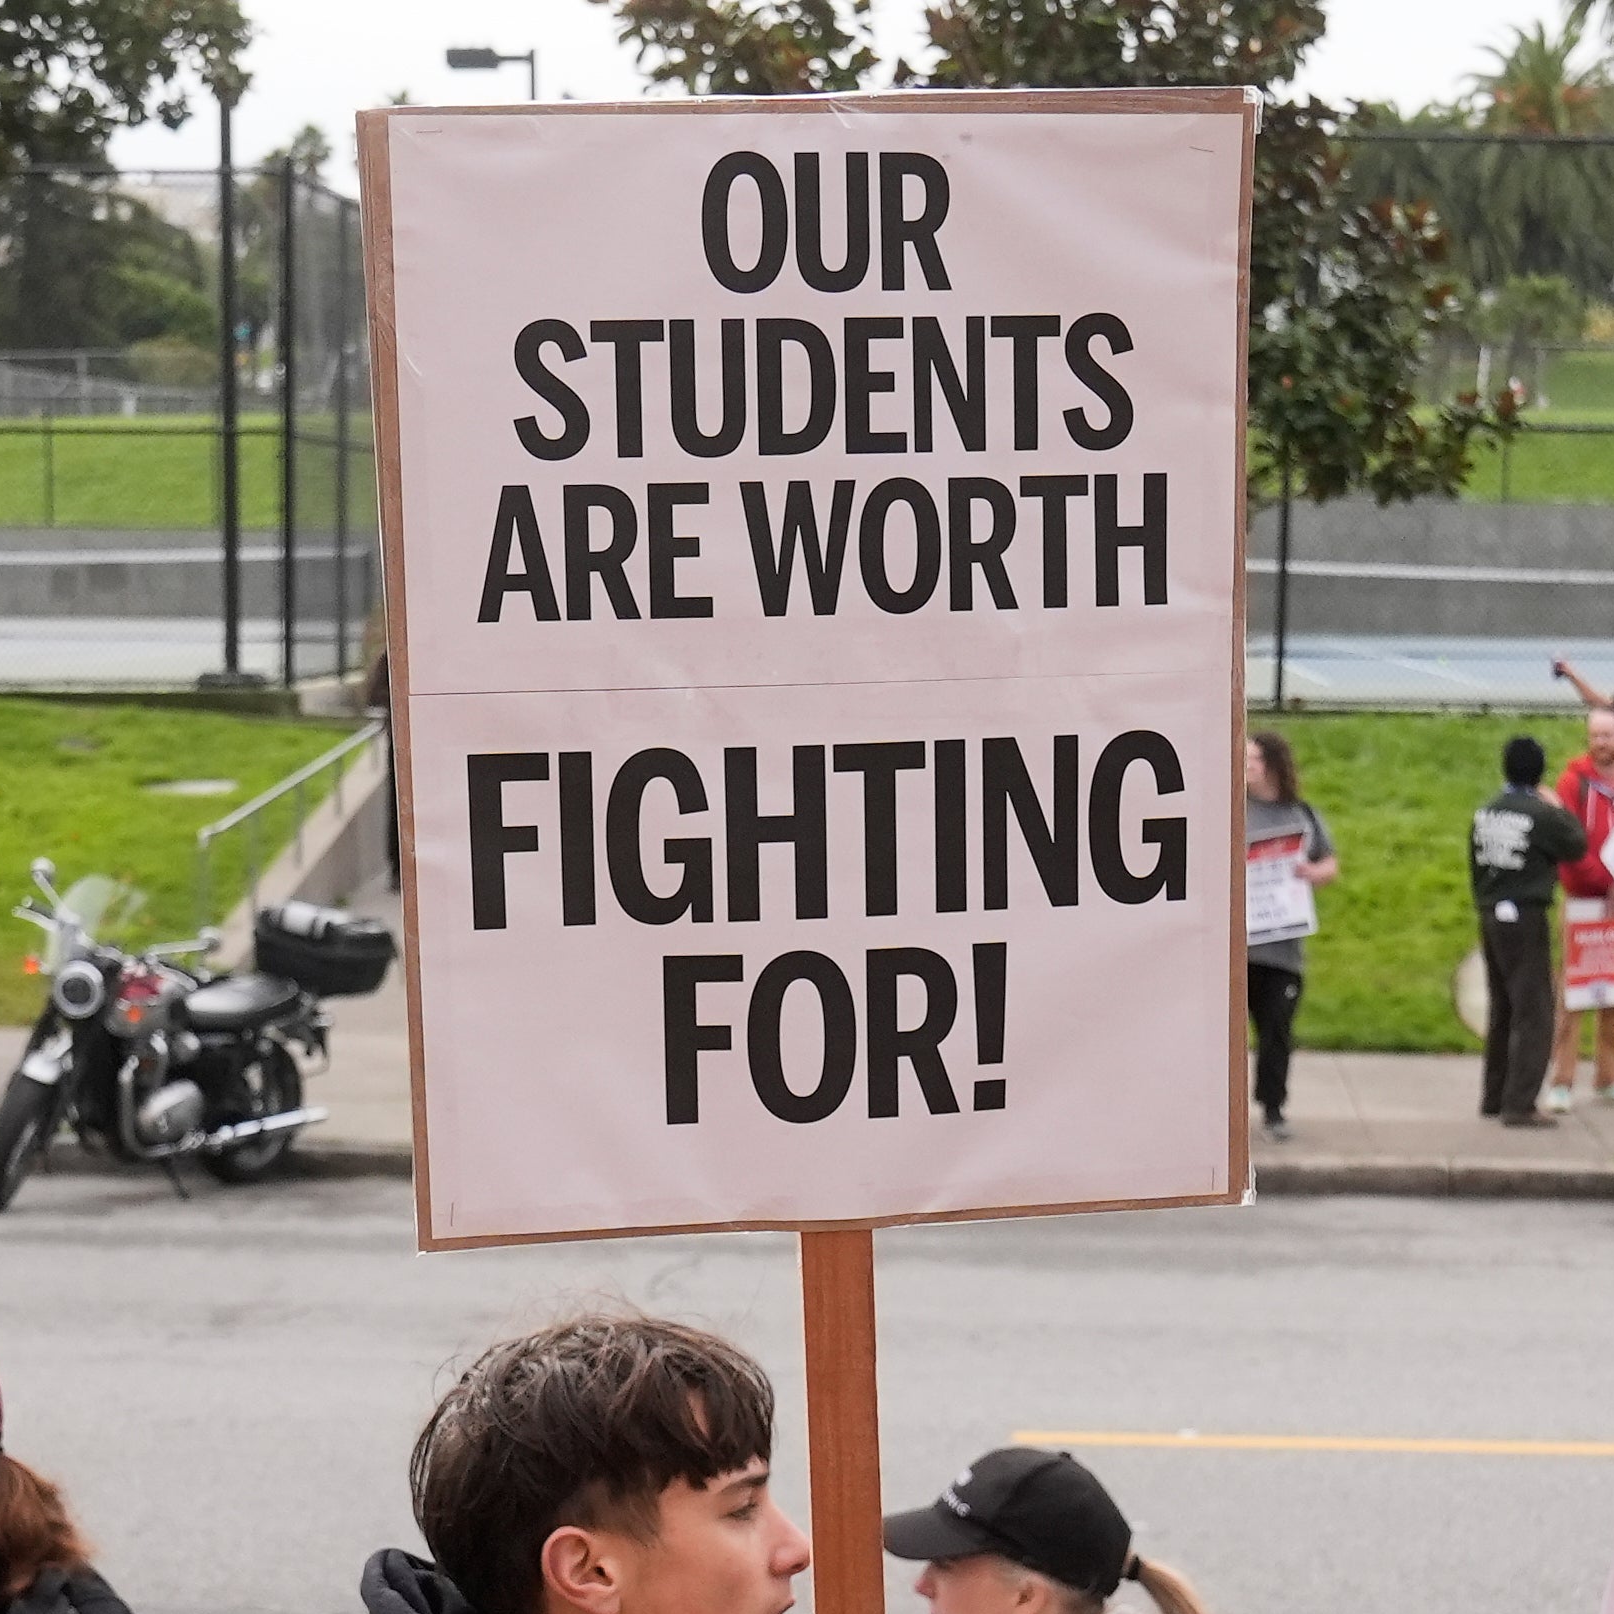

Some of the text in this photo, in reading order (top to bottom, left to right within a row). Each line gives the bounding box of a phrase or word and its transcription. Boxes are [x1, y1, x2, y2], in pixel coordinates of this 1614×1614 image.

[701, 150, 953, 294] OUR
[513, 312, 1135, 462] STUDENTS
[476, 472, 1169, 624] ARE WORTH
[466, 729, 1189, 931] FIGHTING
[662, 941, 1009, 1126] FOR!
